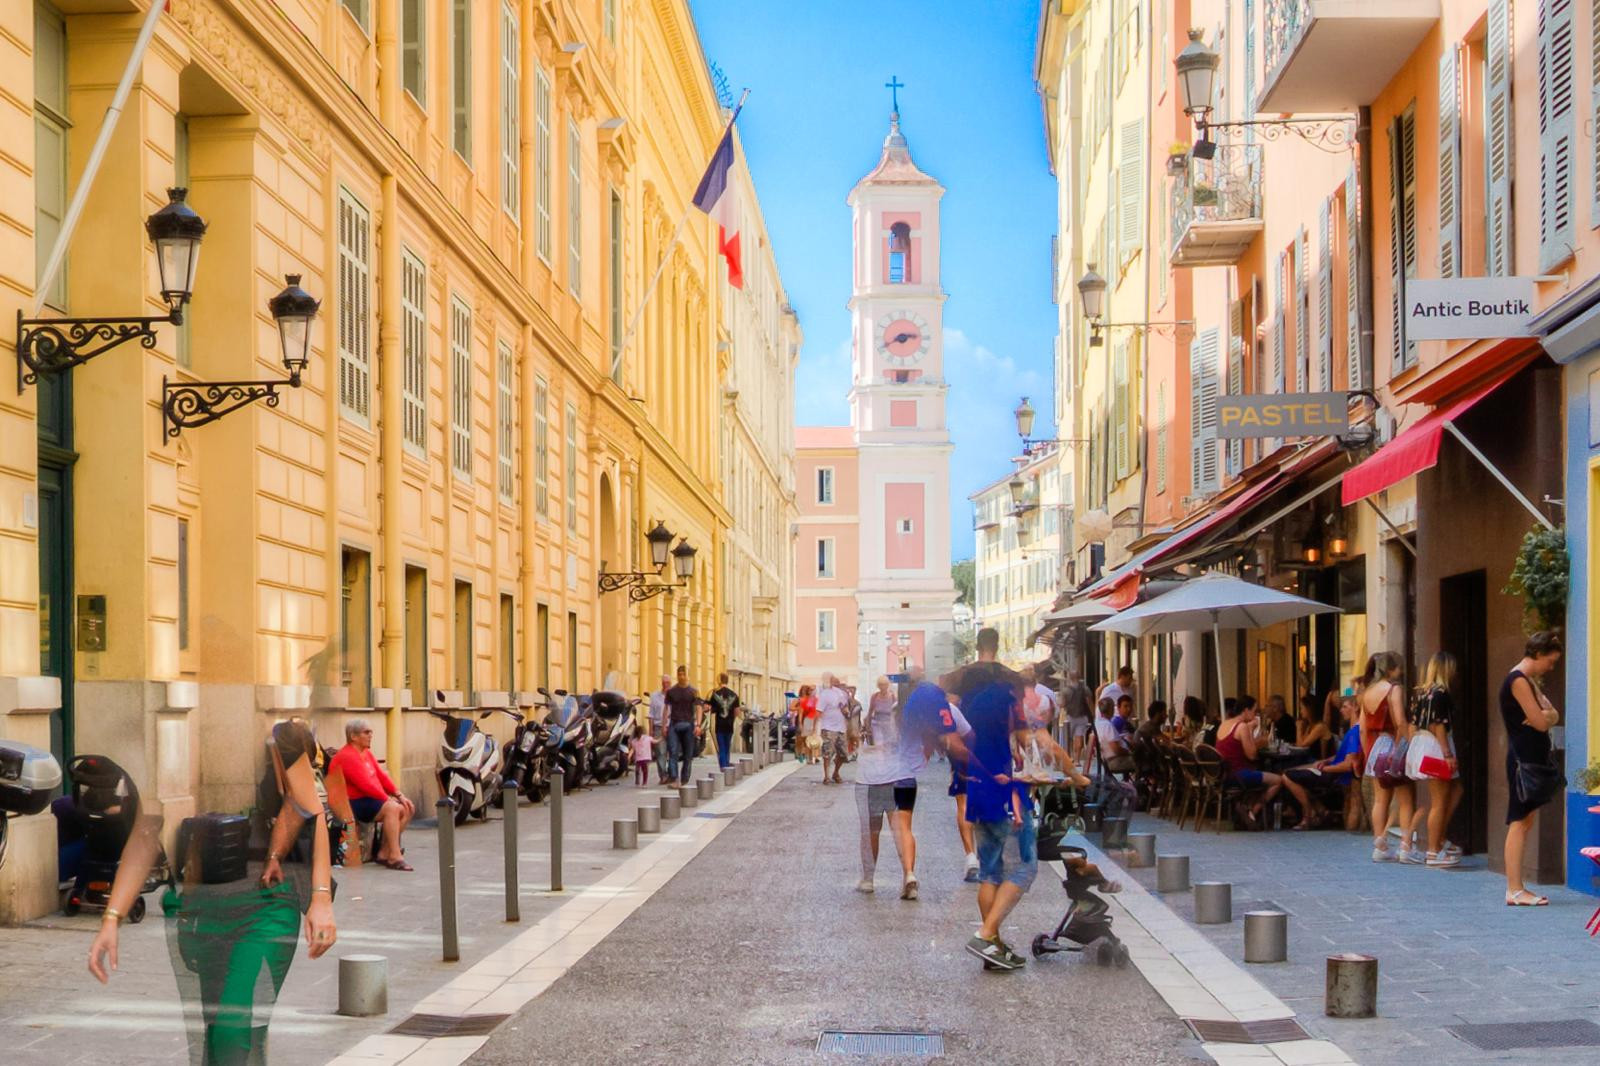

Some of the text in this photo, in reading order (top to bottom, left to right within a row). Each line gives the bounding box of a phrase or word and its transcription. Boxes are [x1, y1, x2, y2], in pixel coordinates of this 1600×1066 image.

[1412, 300, 1529, 317] Antic Boutik
[1221, 403, 1342, 427] PASTEL
